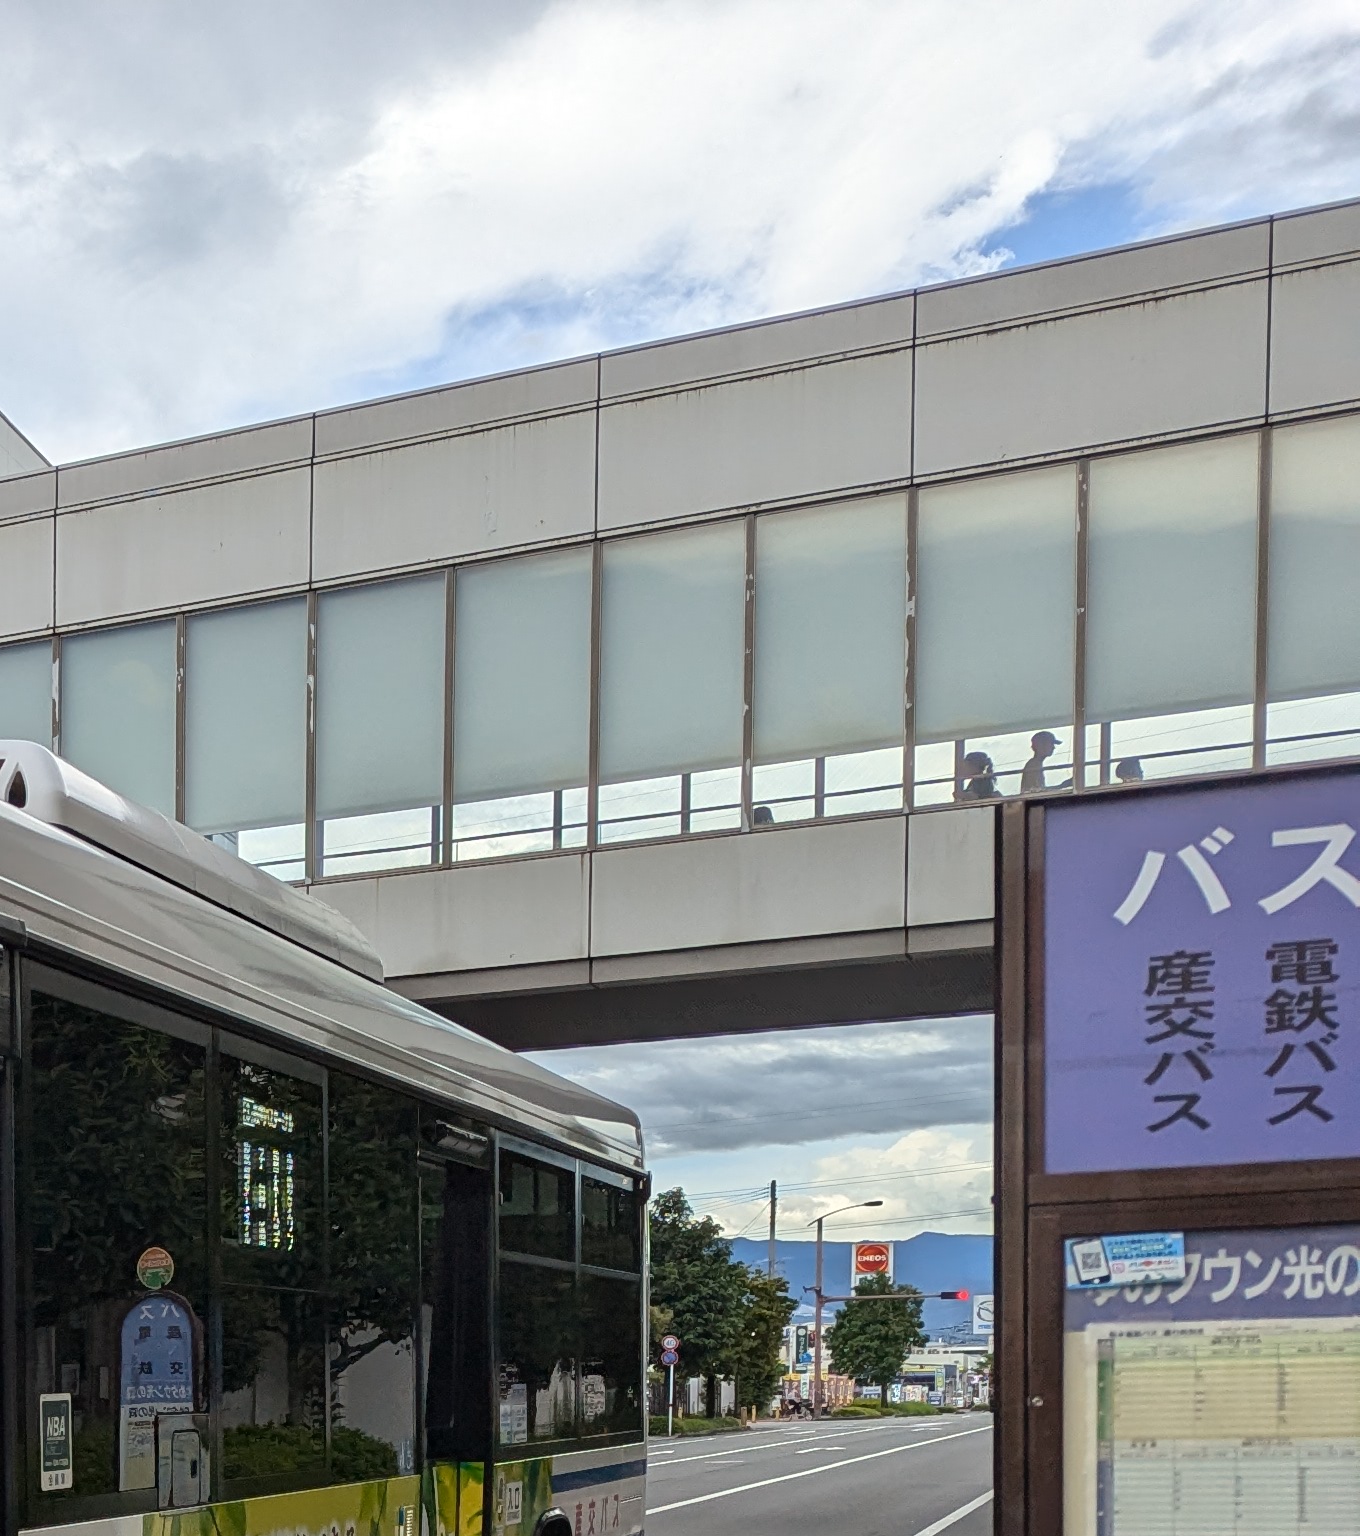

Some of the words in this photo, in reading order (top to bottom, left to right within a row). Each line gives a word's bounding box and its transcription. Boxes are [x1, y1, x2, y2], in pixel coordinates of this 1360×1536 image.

[1112, 822, 1360, 926] バス
[1143, 950, 1216, 1132] 産交バス
[1263, 937, 1340, 1126] 電鉄バス
[47, 1416, 66, 1437] NBA
